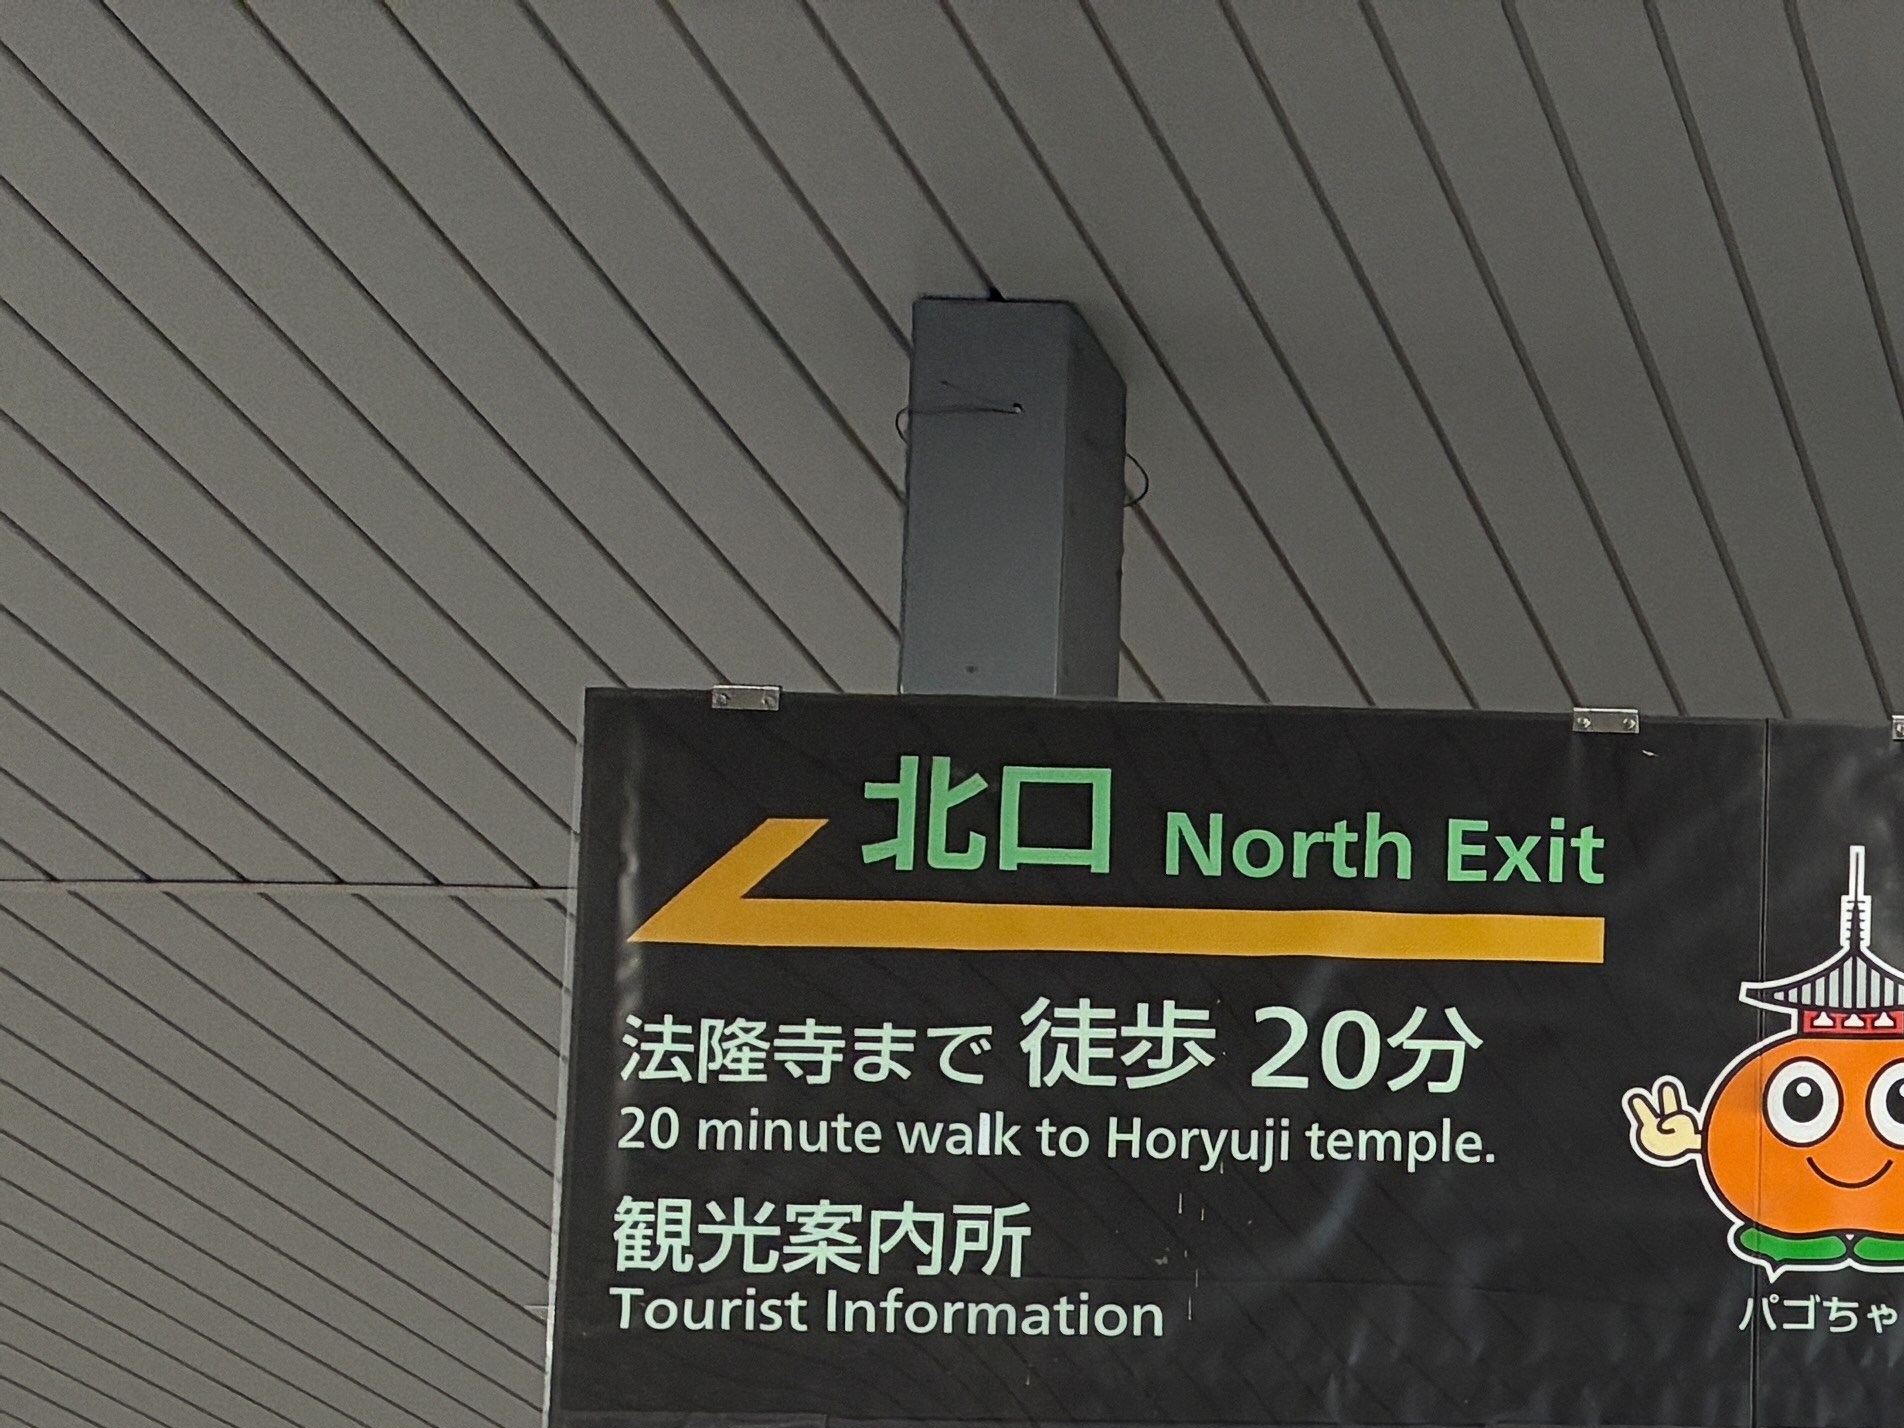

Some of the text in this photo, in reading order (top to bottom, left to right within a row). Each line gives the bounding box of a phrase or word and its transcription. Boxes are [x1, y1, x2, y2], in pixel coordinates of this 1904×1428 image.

[861, 754, 1112, 872] 北口
[1164, 810, 1605, 885] North Exit
[619, 998, 1485, 1092] 法隆寺まで 徒歩 20分
[618, 1108, 1496, 1172] 20 minute walk to Horyuji temple.
[612, 1198, 1031, 1278] 観光案内所
[610, 1290, 1165, 1338] Tourist Information
